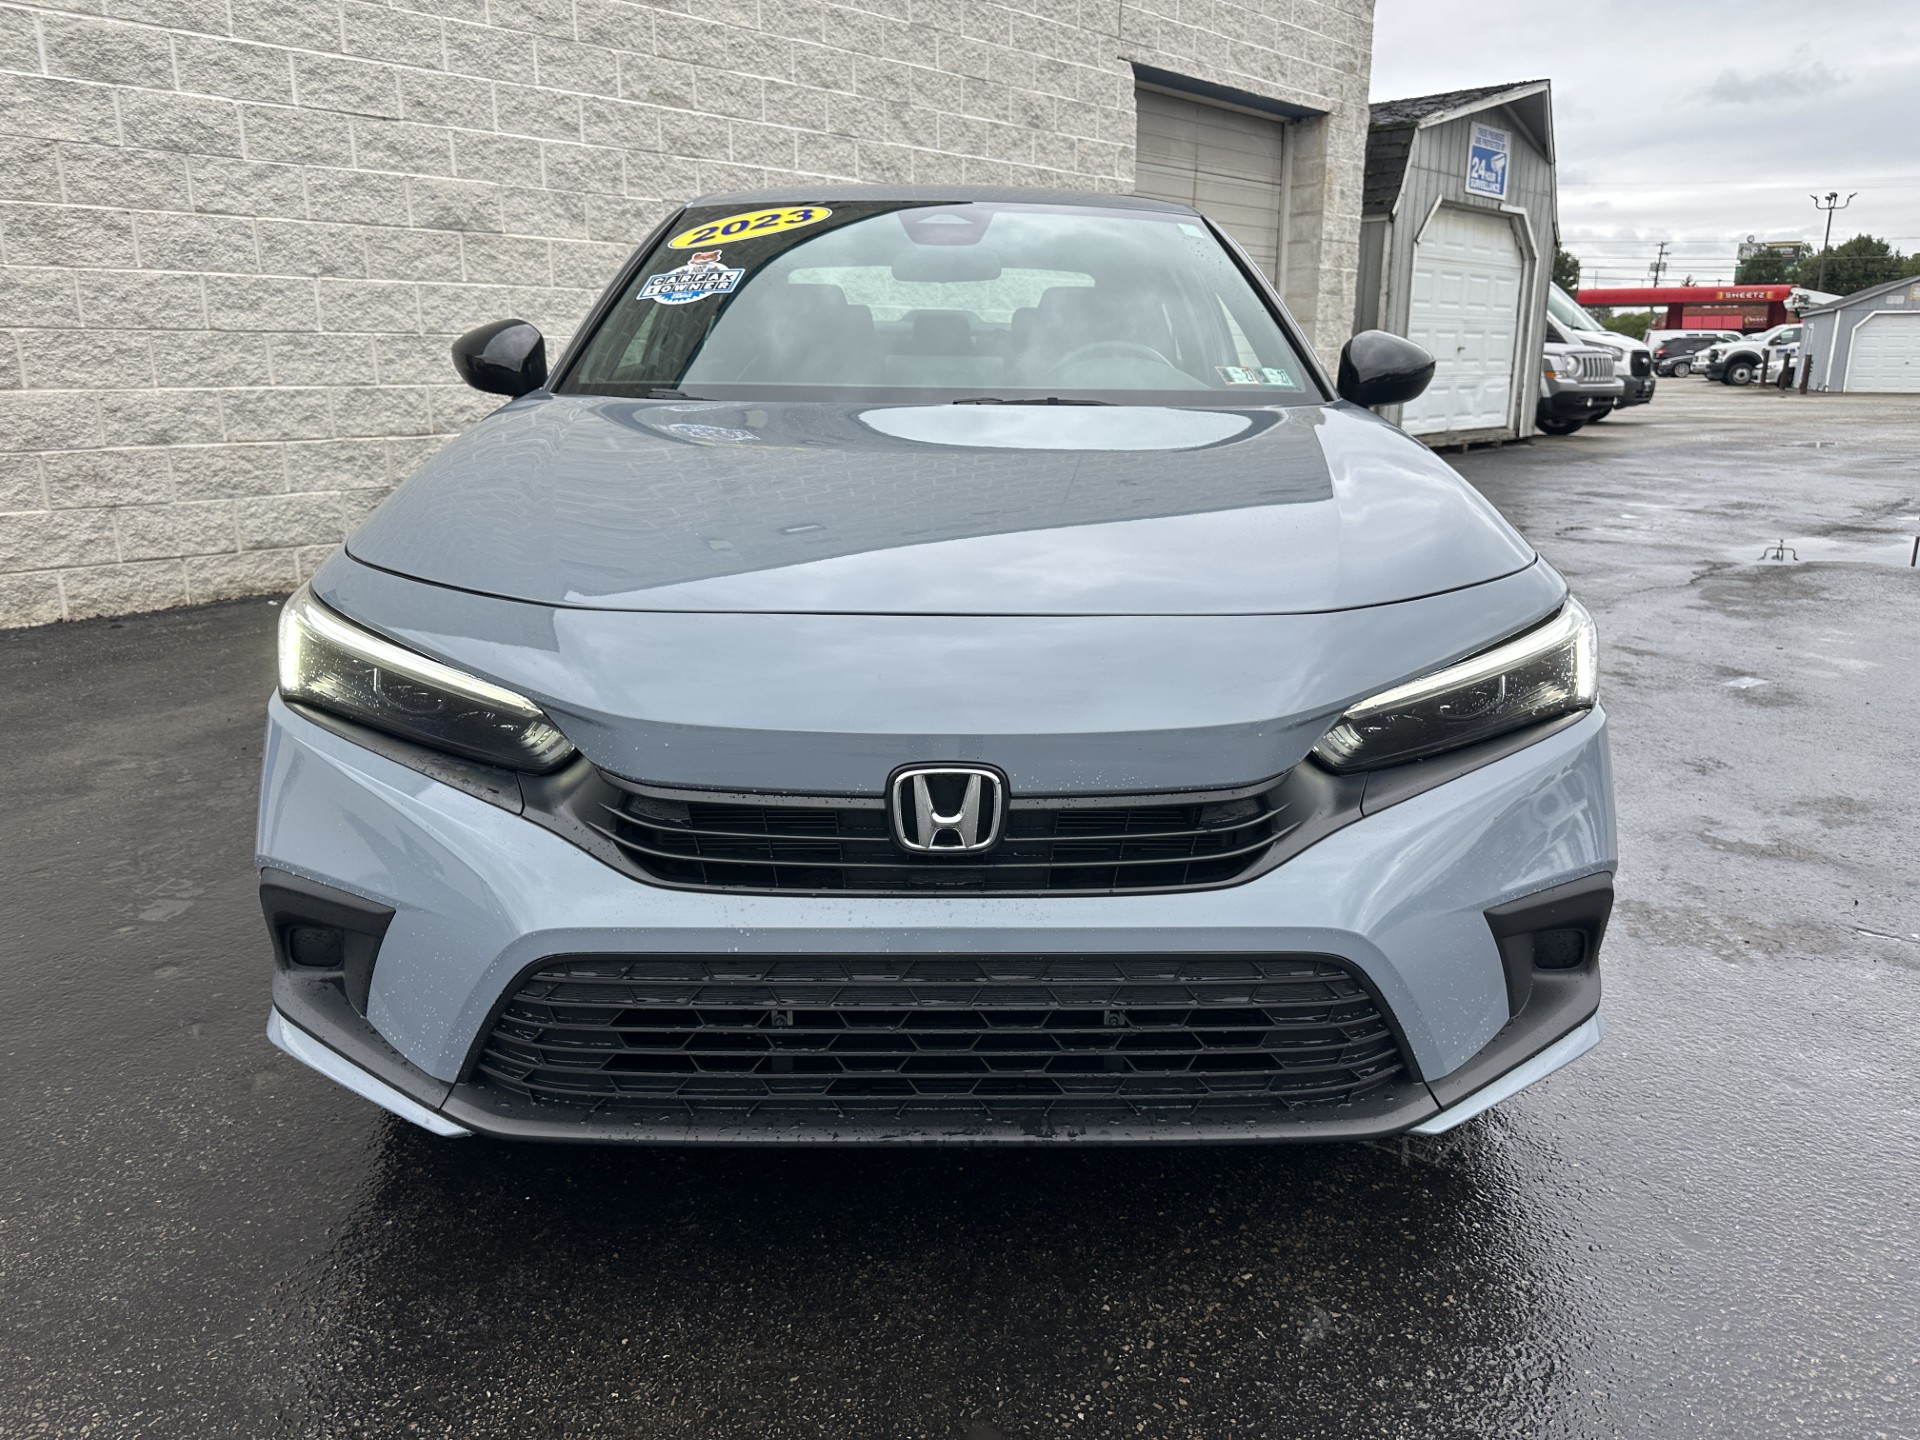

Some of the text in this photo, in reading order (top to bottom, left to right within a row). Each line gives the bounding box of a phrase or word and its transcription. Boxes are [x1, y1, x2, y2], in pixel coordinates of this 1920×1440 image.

[1471, 157, 1486, 179] 24
[687, 209, 815, 245] 2023
[652, 272, 734, 286] CARFAX
[660, 281, 730, 293] OWNER
[1725, 291, 1765, 299] SHEETZ
